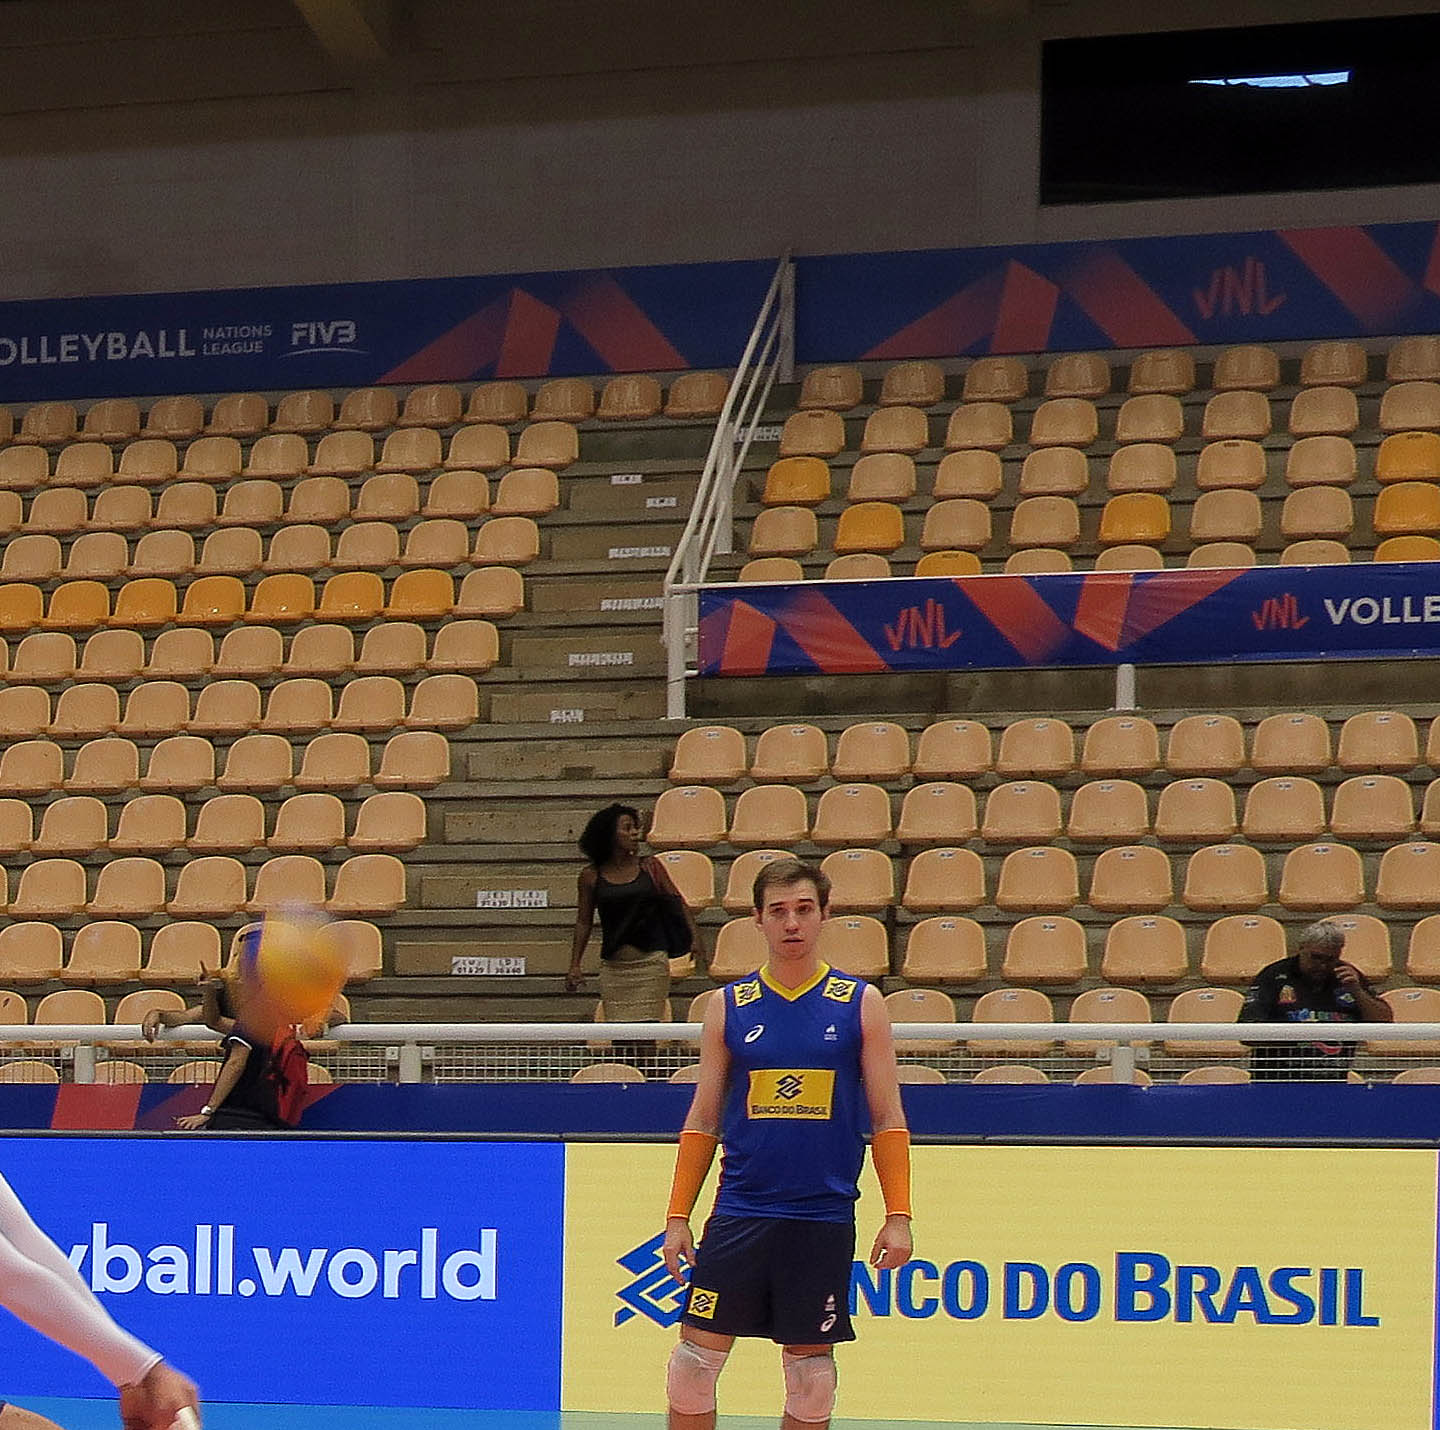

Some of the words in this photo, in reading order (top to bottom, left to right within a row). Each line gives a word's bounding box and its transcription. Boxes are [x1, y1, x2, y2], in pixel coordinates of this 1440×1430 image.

[202, 324, 272, 339] NATIONS
[291, 320, 357, 347] FIVB
[202, 339, 264, 356] LEAGUE
[1323, 595, 1440, 625] VOLLE
[751, 1104, 781, 1115] BANCO
[782, 1105, 795, 1115] DO
[796, 1104, 827, 1116] BRASIL
[850, 1260, 989, 1321] NCO
[1004, 1262, 1102, 1323] DO
[1115, 1251, 1382, 1328] BRASIL
